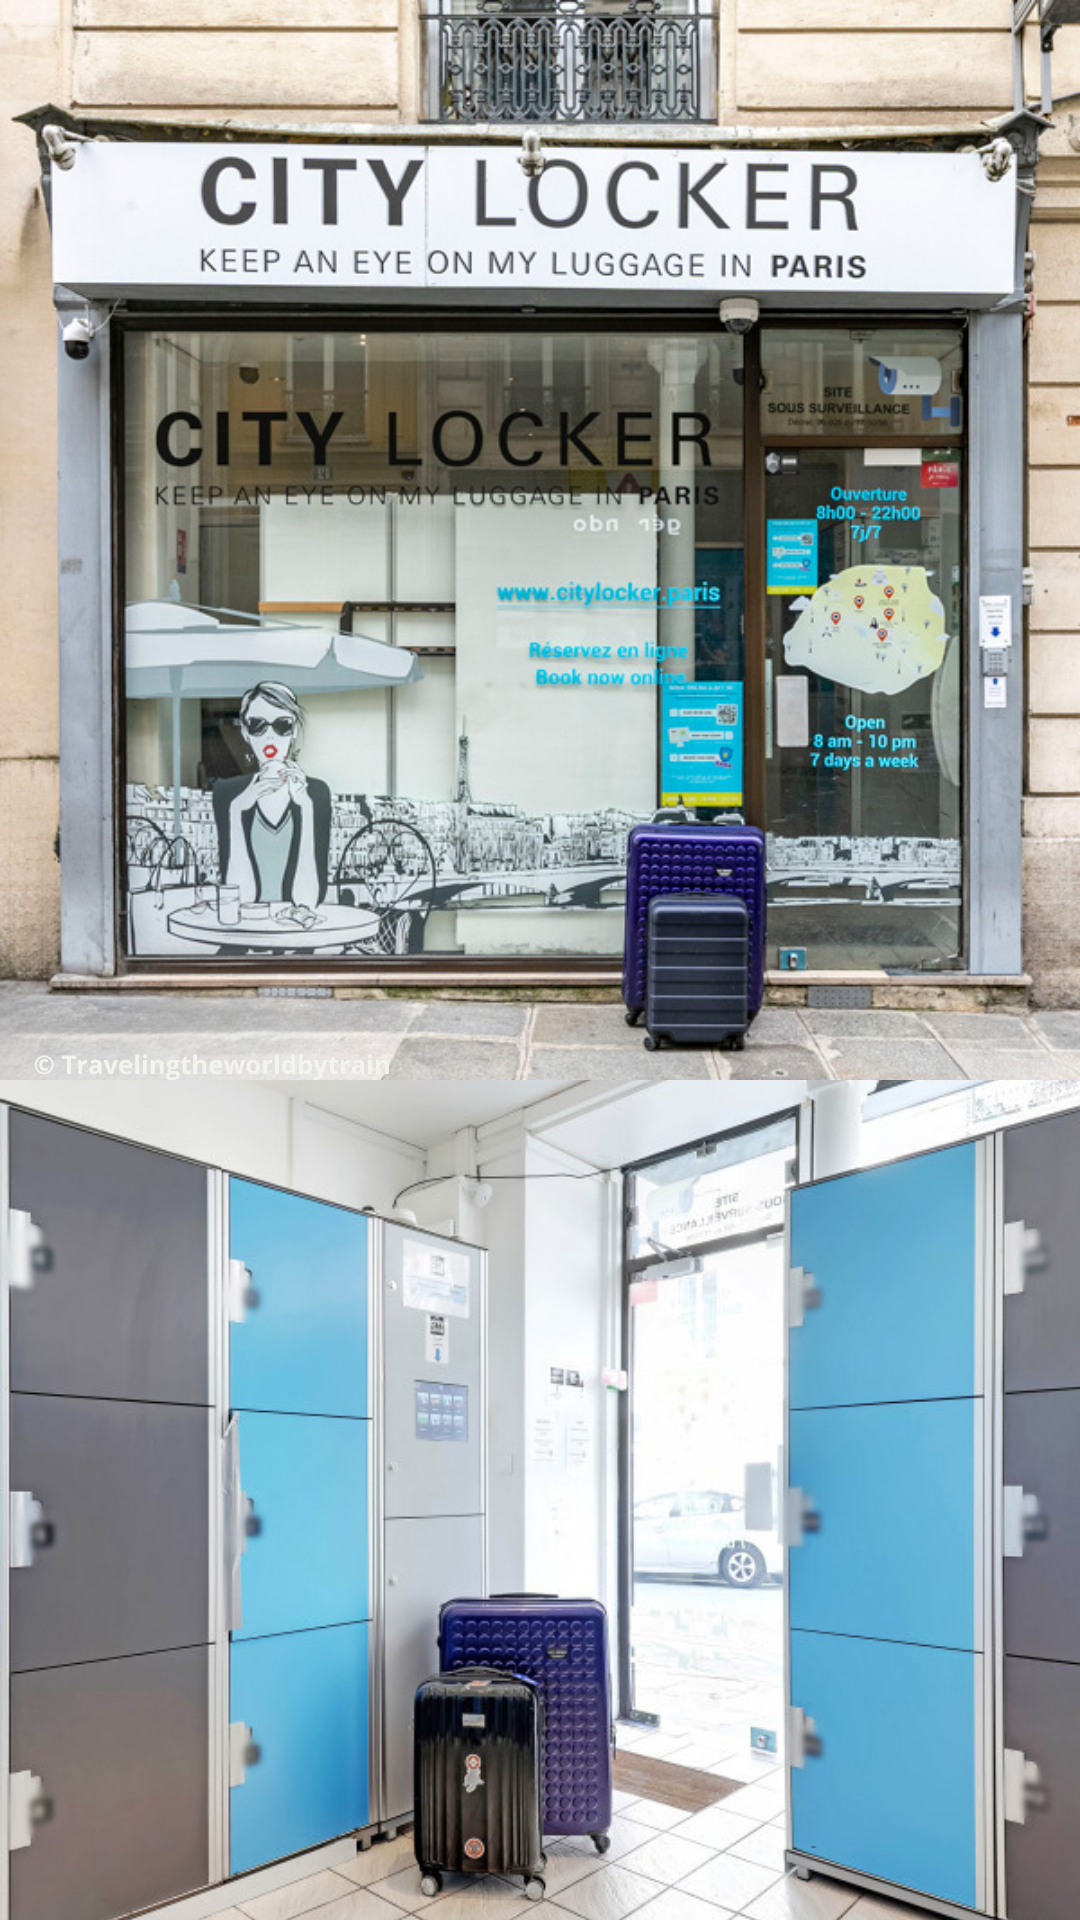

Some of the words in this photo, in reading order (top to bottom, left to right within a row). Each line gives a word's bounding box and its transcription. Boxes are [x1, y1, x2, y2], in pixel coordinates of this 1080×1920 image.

[201, 156, 424, 226] CITY
[475, 158, 859, 231] LOCKER
[200, 249, 281, 273] KEEP
[293, 250, 337, 274] AN
[353, 251, 412, 274] EYE
[427, 250, 473, 274] ON
[488, 251, 537, 275] MY
[552, 251, 705, 277] LUGGAGE
[720, 253, 751, 278] IN
[771, 254, 867, 279] PARIS
[823, 386, 853, 398] SITE
[768, 402, 805, 414] SOUS
[809, 402, 911, 415] SURVEILLANCE
[155, 411, 344, 467] CITY
[388, 410, 712, 468] LOCKER
[155, 486, 224, 505] KEEP
[233, 486, 271, 505] AN
[285, 486, 334, 505] EYE
[347, 485, 386, 505] ON
[400, 486, 440, 505] MY
[453, 485, 583, 506] LUGGAGE
[597, 486, 622, 506] IN
[639, 485, 720, 506] PARIS
[830, 486, 908, 502] Ouverture
[816, 505, 856, 521] 8h00
[871, 505, 921, 521] 22h00
[850, 524, 883, 543] 7j/7
[496, 581, 721, 606] www.citylocker.paris
[529, 641, 612, 659] Réservez
[617, 645, 639, 659] en
[644, 641, 689, 663] ligne
[535, 668, 582, 686] Book
[588, 672, 626, 686] now
[631, 668, 687, 686] online
[844, 714, 886, 733] Open
[812, 734, 824, 748] 8
[827, 737, 852, 748] am
[869, 734, 888, 748] 10
[891, 737, 917, 752] pm
[810, 753, 820, 767] 7
[824, 752, 861, 771] days
[864, 756, 874, 768] a
[878, 753, 919, 768] week
